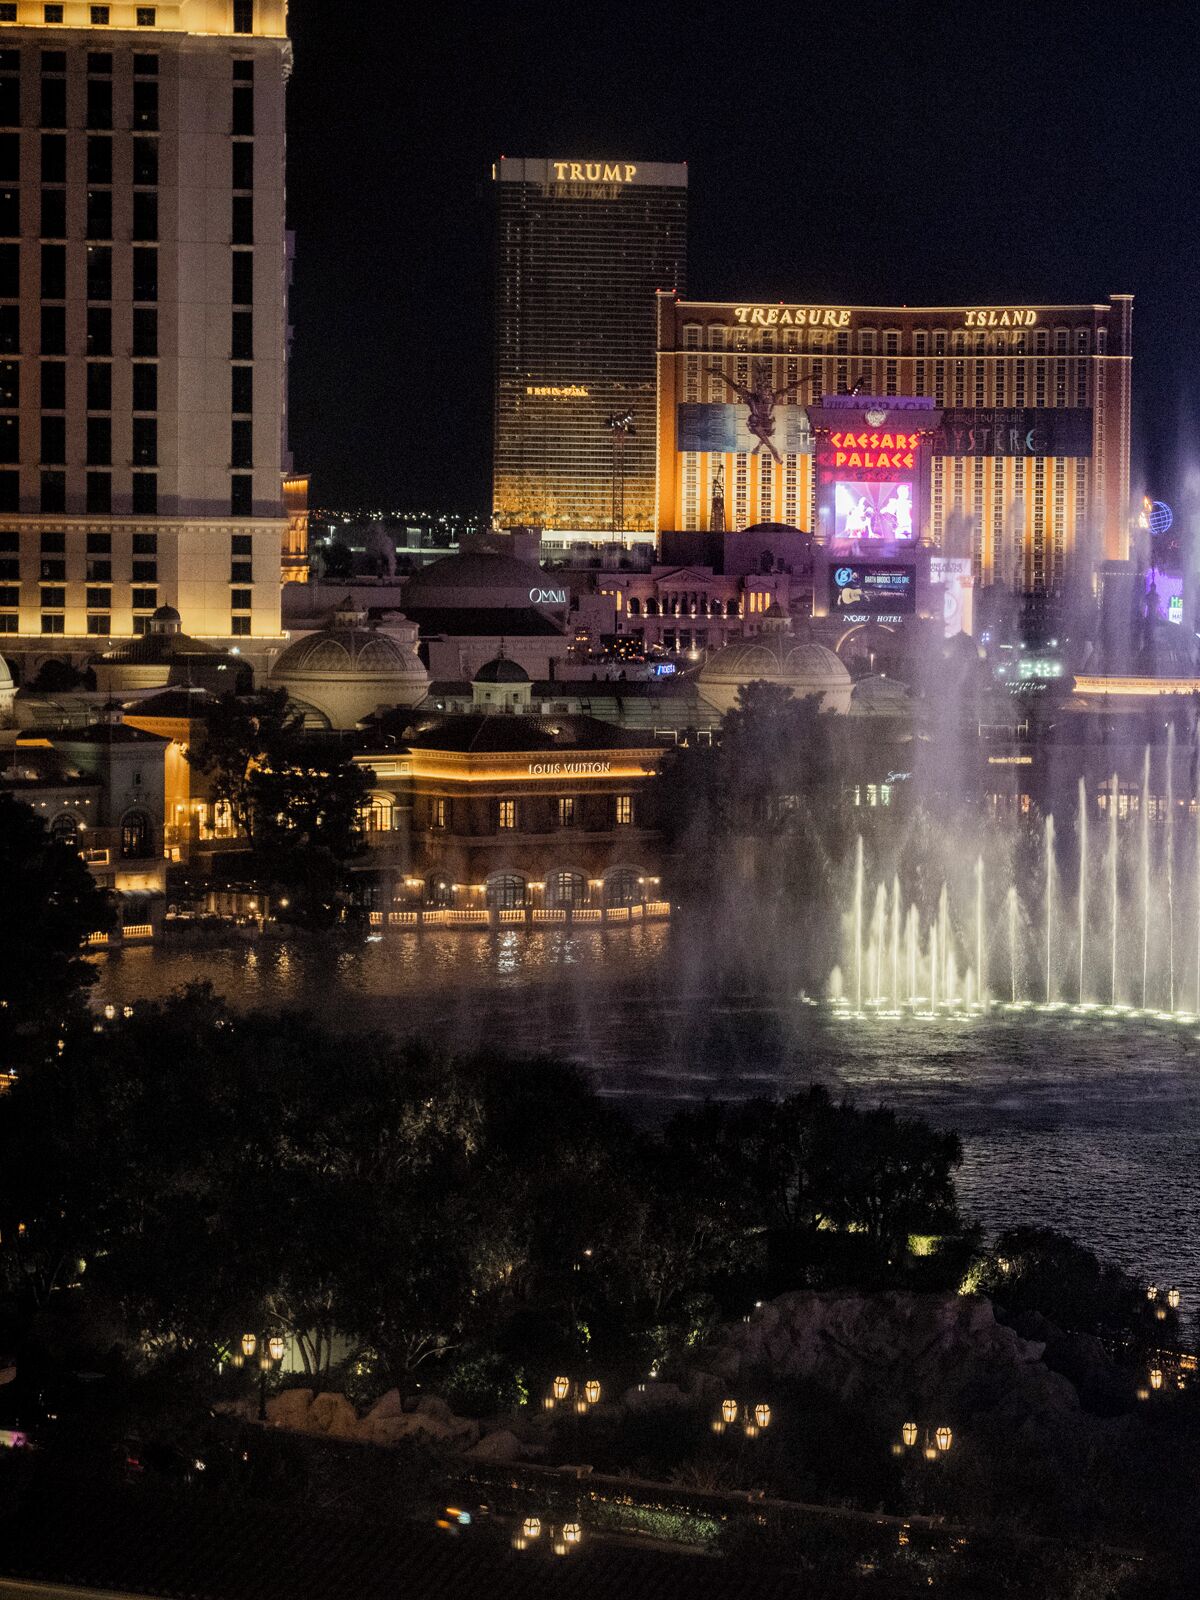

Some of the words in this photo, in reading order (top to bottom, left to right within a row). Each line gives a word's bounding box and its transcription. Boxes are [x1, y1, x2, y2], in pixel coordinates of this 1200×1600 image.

[553, 162, 637, 182] TRUMP
[735, 307, 851, 327] TREASURE
[965, 310, 1037, 326] ISLAND
[831, 432, 919, 449] CAESARS
[836, 452, 914, 468] PALACE
[843, 614, 870, 622] NOBU
[877, 615, 903, 623] HOTEL
[528, 763, 560, 774] LOUIS
[563, 762, 611, 773] VUITTON
